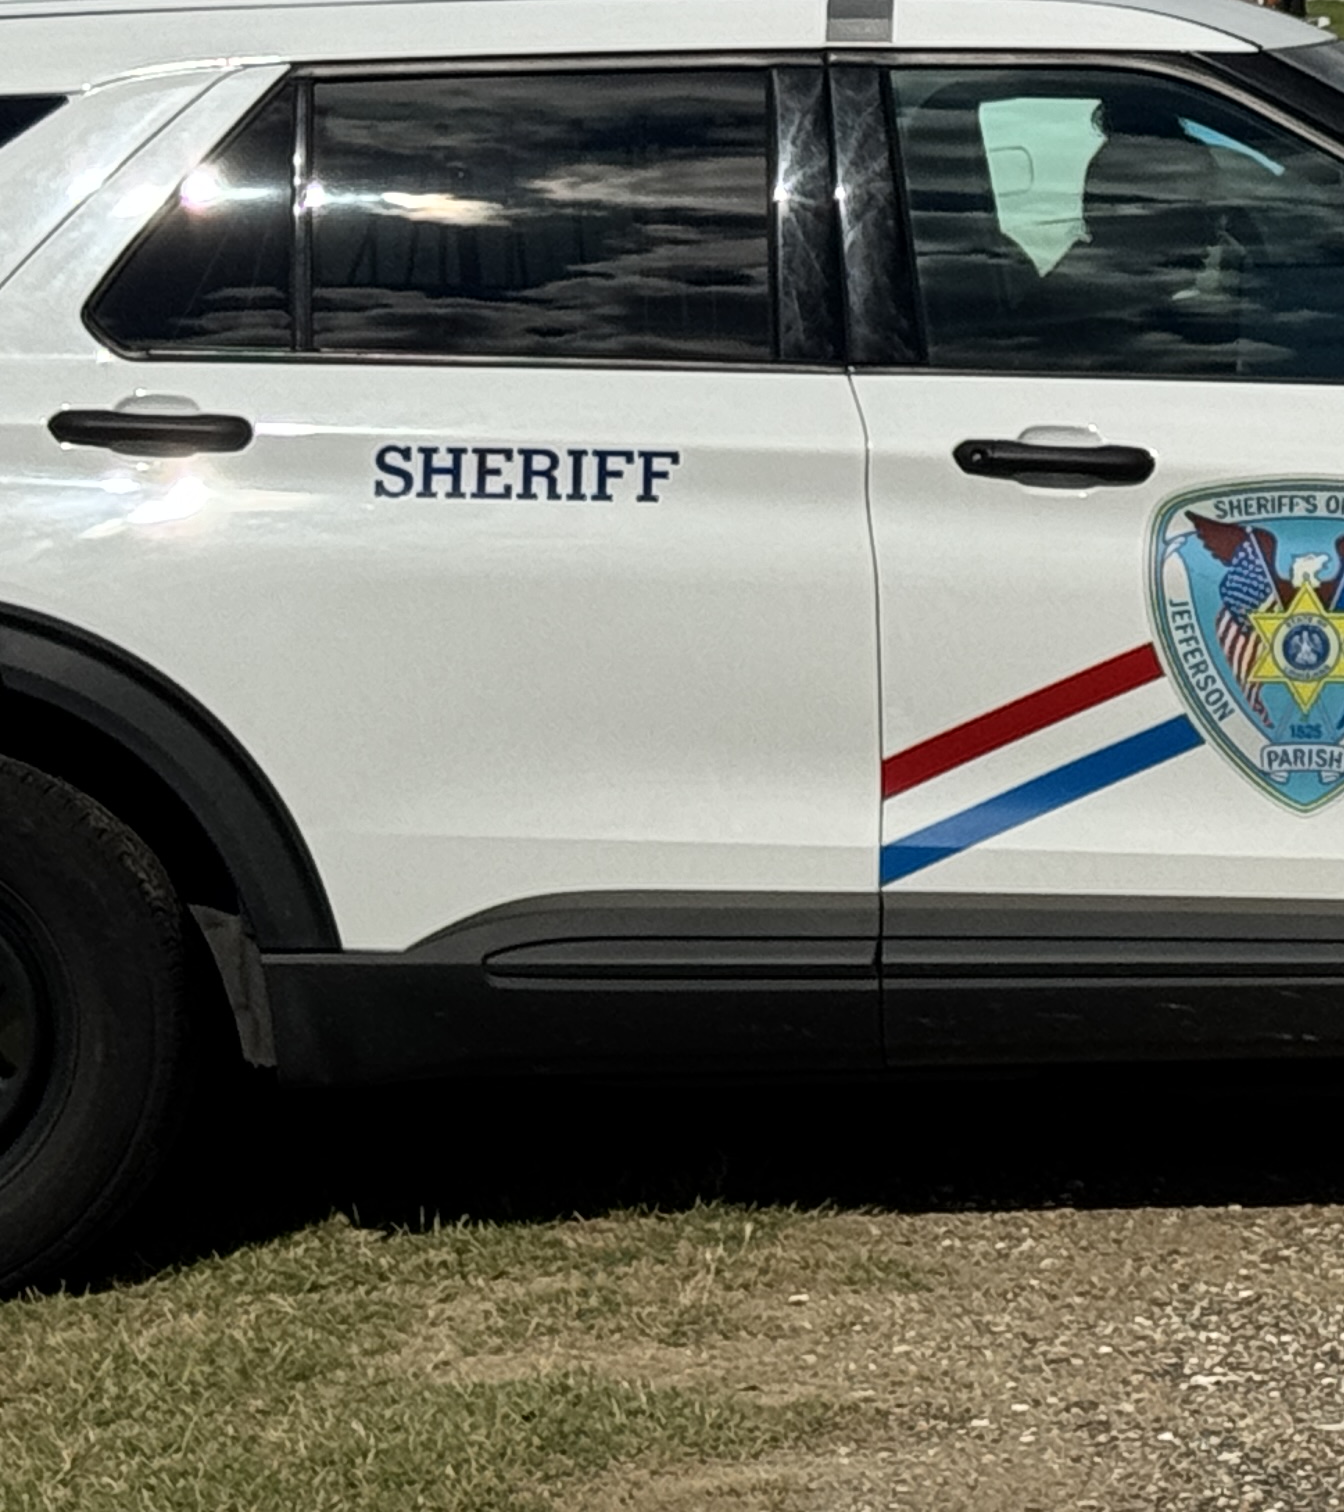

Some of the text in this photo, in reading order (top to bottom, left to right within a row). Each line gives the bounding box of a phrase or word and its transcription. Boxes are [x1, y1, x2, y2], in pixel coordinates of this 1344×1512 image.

[374, 445, 680, 502] SHERIFF
[1213, 494, 1318, 520] SHERIFF'S
[1168, 598, 1236, 722] JEFFERSON
[1266, 749, 1344, 771] PARISH
